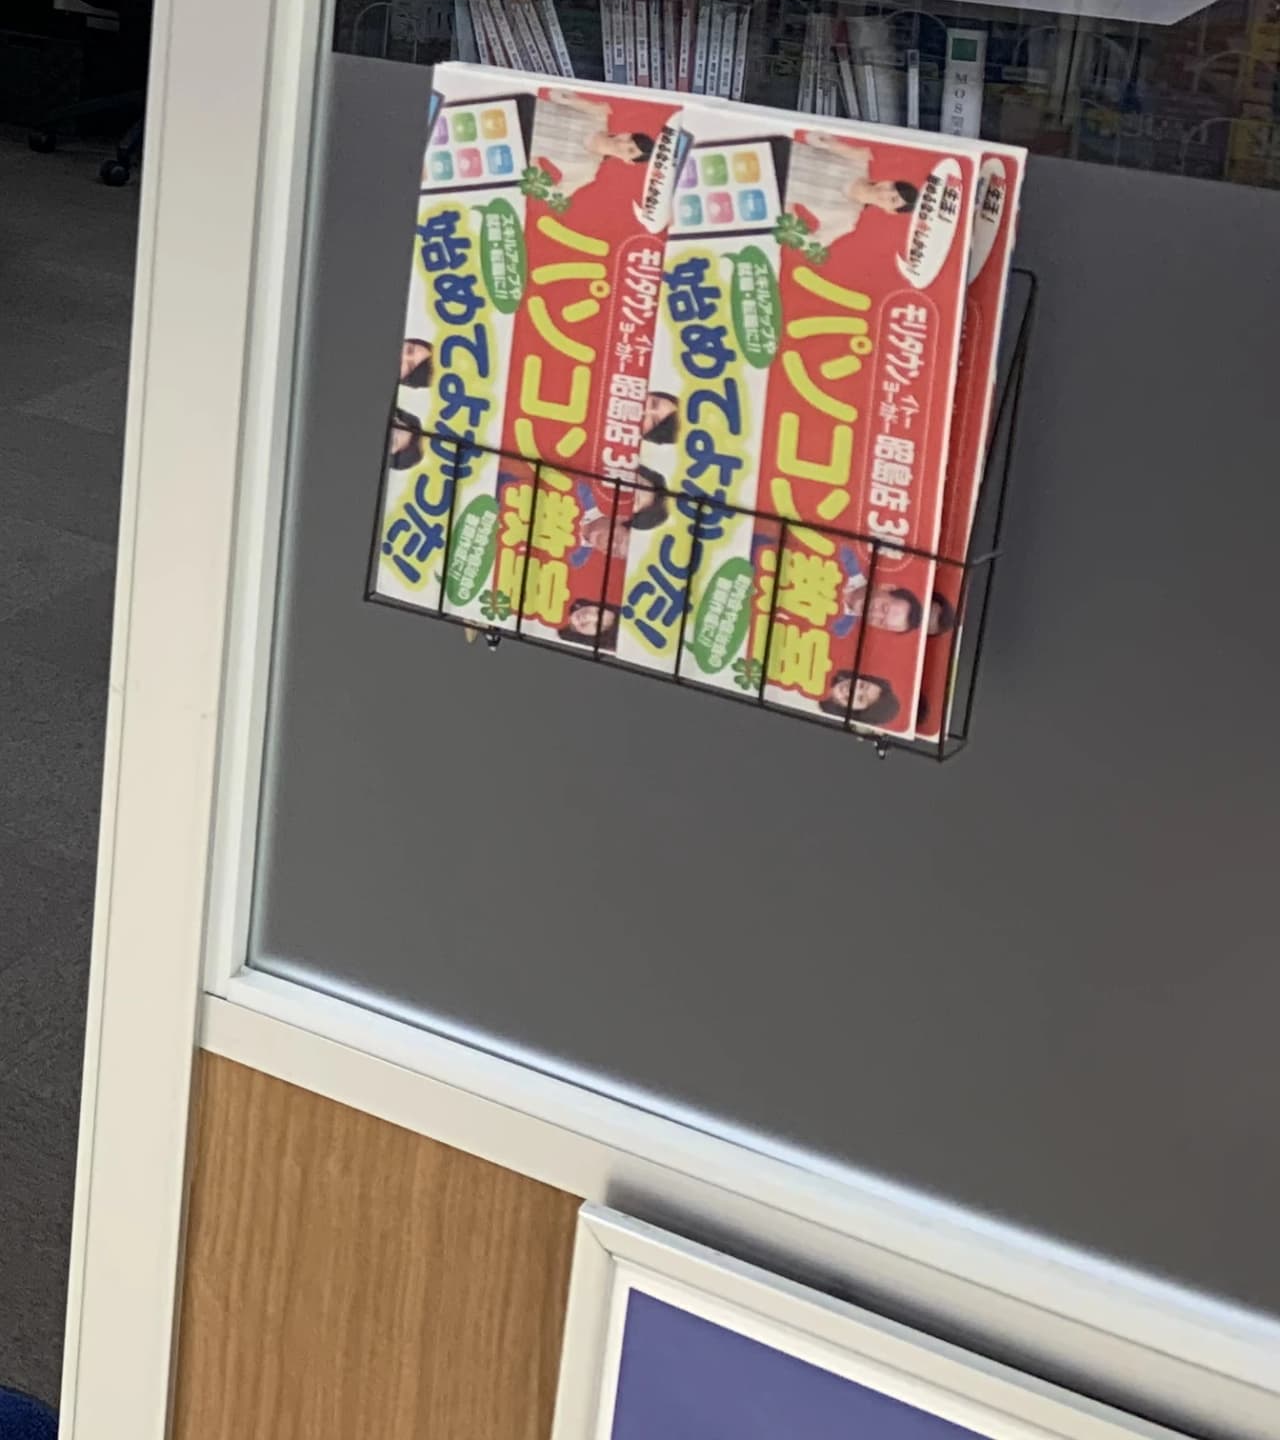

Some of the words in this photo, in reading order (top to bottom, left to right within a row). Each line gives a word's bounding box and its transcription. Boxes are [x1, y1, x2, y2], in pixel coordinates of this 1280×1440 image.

[500, 213, 525, 299] スキルアップや
[621, 247, 660, 322] モリタウン
[753, 260, 777, 354] スキルアップや
[883, 303, 927, 383] モリタウン
[381, 209, 490, 587] 始めてよかった!
[499, 215, 611, 624] パソコン教室
[603, 374, 645, 446] 昭島店
[623, 257, 742, 650] 始めてよかった!
[765, 268, 871, 697] パソコン教室
[869, 434, 915, 510] 昭島店
